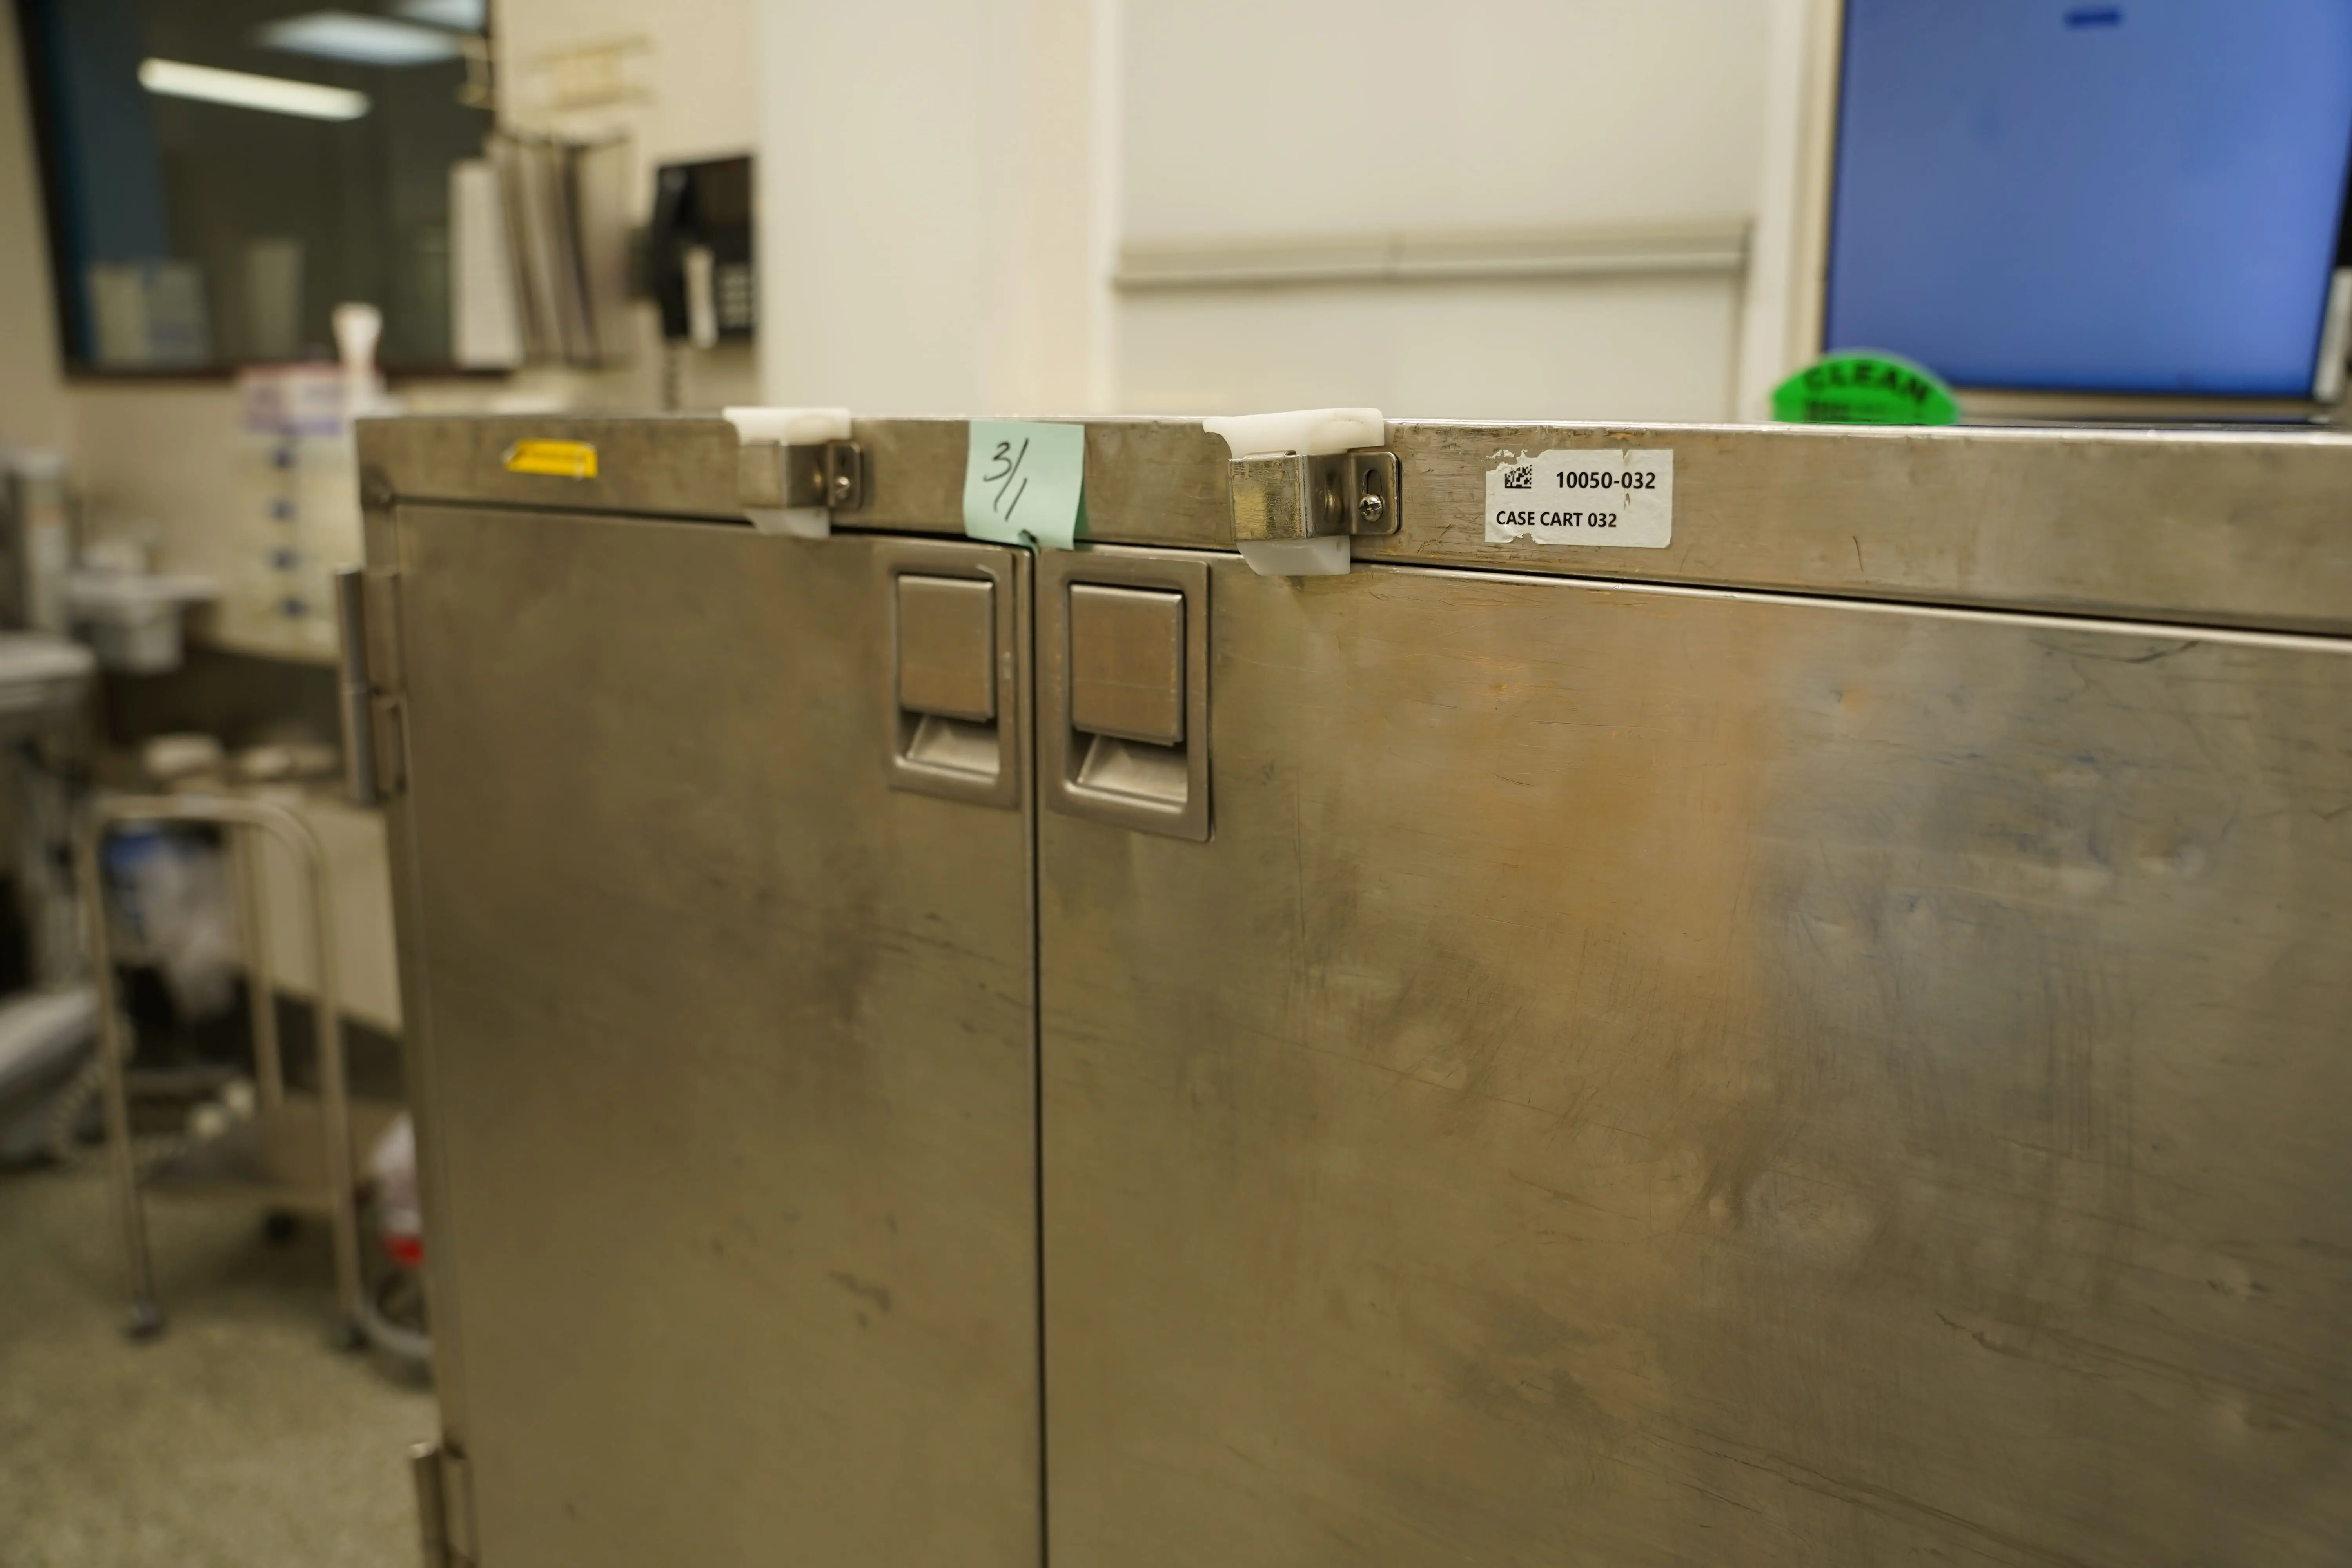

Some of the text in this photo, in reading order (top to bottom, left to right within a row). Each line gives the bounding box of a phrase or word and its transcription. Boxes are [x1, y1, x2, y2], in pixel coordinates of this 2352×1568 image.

[1802, 362, 1929, 404] CLEAN
[983, 437, 1029, 521] 3/1
[1556, 472, 1655, 489] 10050-032
[1496, 511, 1617, 528] CASE CART 032
